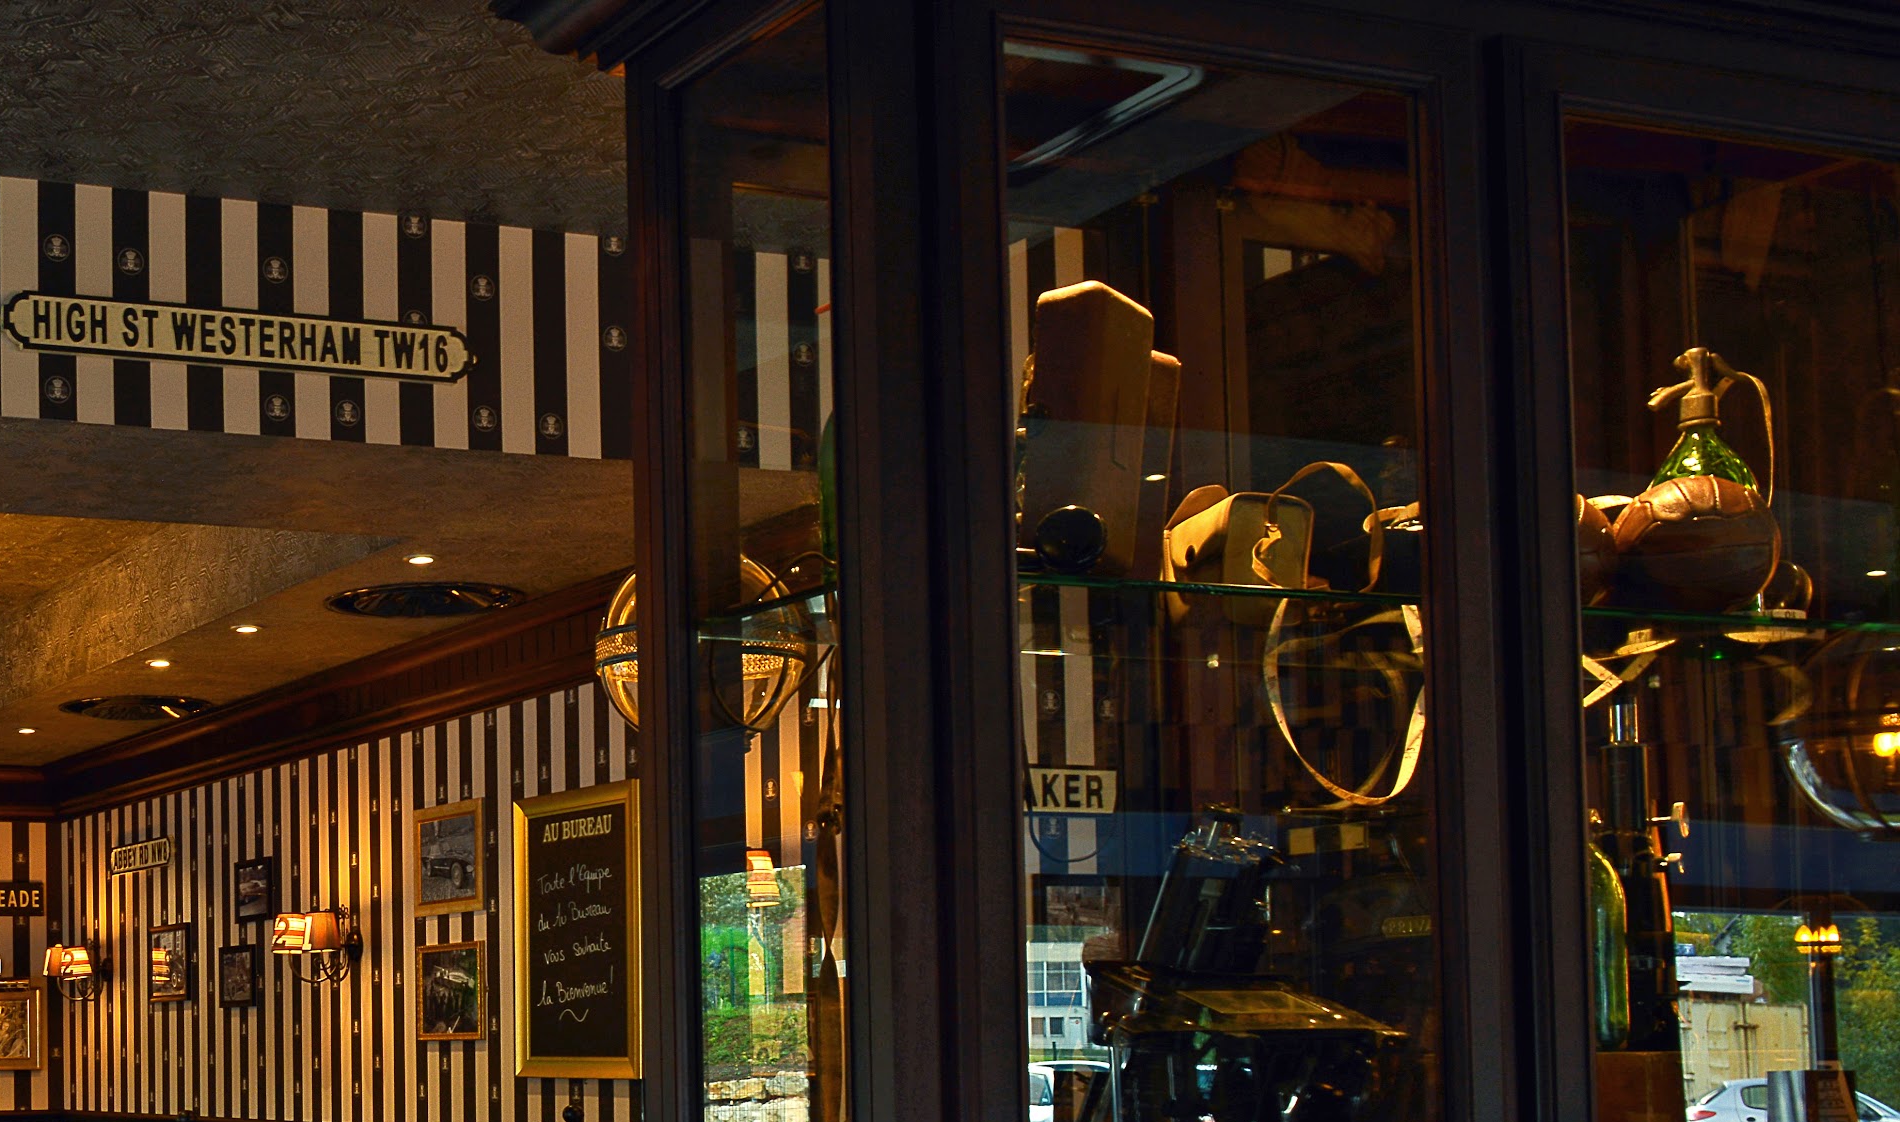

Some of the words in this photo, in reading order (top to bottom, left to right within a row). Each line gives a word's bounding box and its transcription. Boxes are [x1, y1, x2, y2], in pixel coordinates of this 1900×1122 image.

[32, 299, 108, 344] HIGH
[122, 308, 159, 348] ST
[171, 312, 362, 366] WESTERHAM
[374, 329, 449, 373] TW16
[542, 821, 559, 843] AU
[562, 814, 612, 841] BUREAU
[114, 846, 137, 870] ABBEY
[140, 844, 149, 866] RD
[152, 841, 167, 863] NW8
[538, 914, 551, 932] du
[571, 902, 611, 921] Bureau
[537, 981, 554, 1007] la
